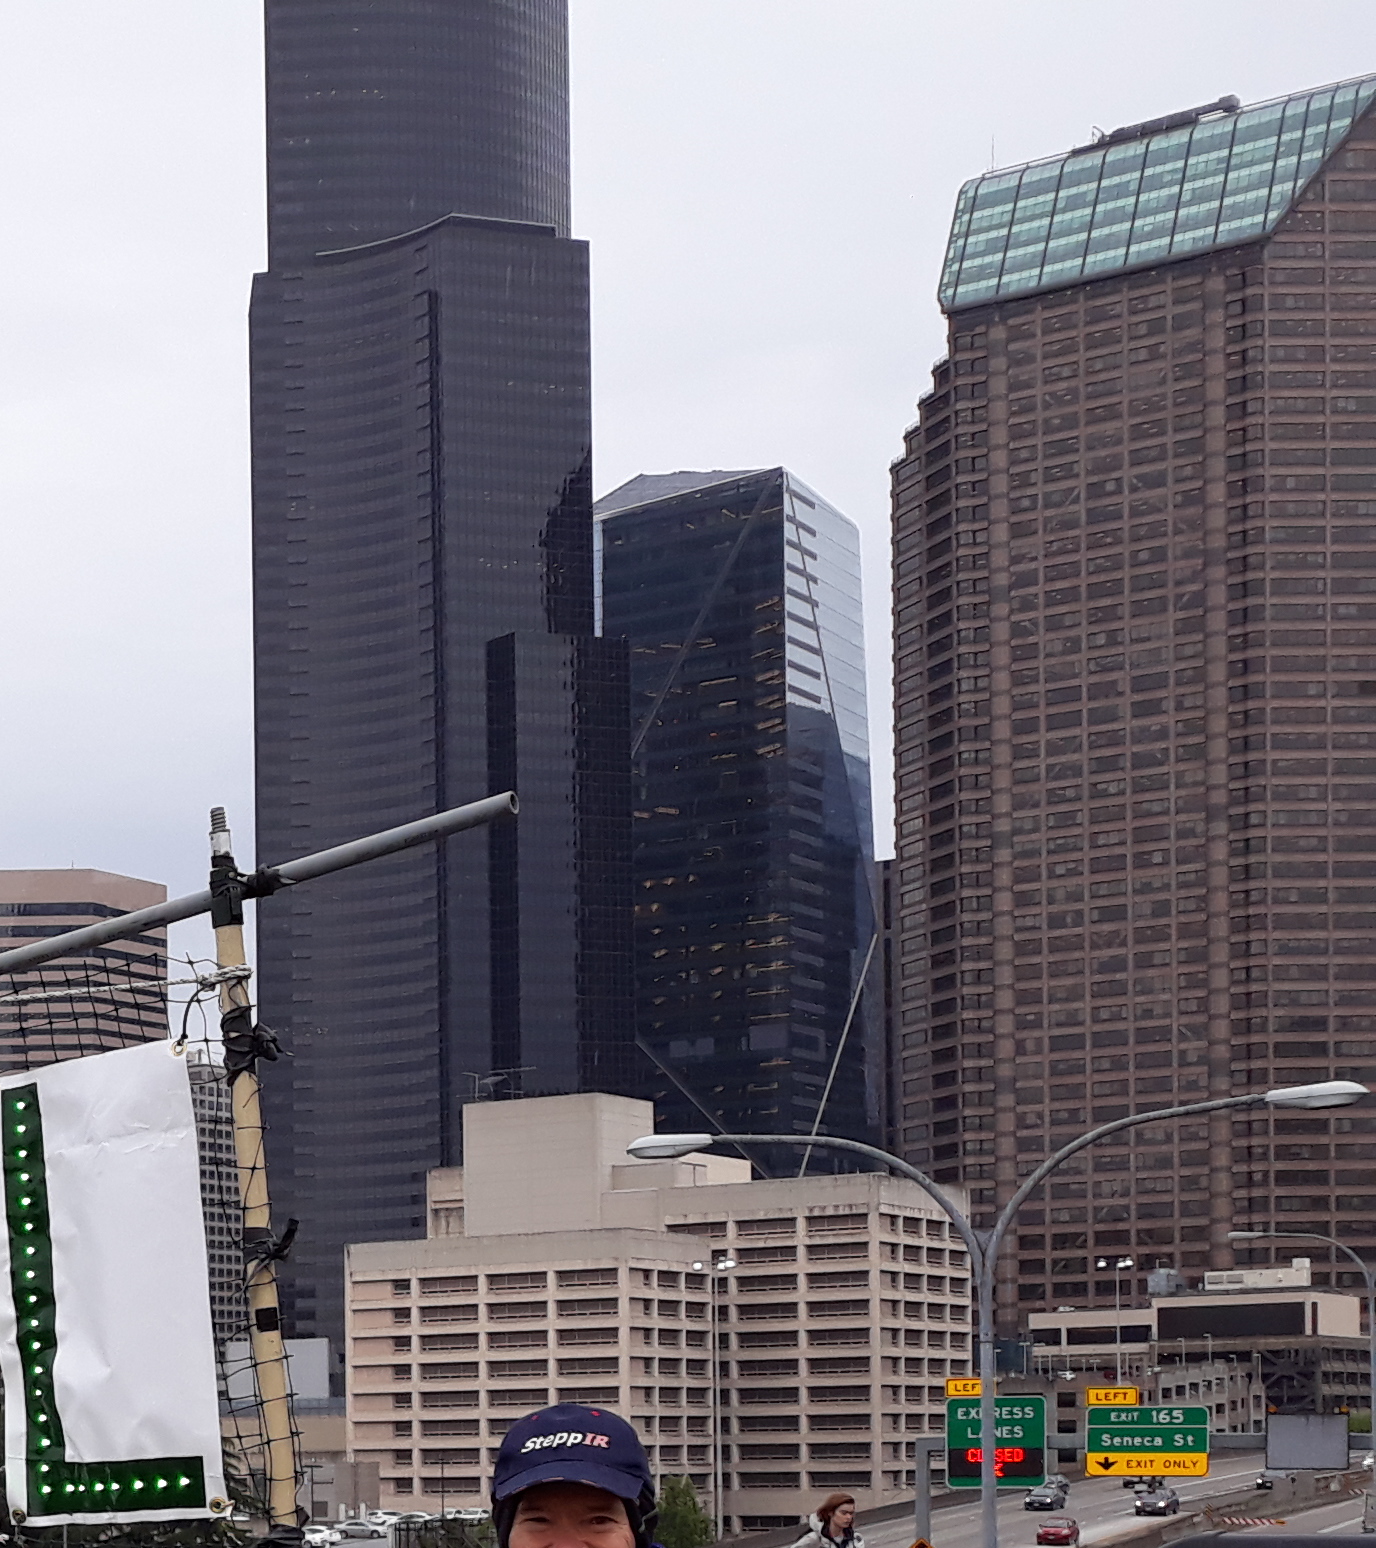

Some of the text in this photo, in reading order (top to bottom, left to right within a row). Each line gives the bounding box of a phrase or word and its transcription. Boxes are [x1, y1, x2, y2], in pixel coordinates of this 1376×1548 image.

[954, 1382, 980, 1392] LEF
[1095, 1392, 1128, 1401] LEFT
[1110, 1409, 1184, 1424] EXIT 165
[520, 1432, 610, 1454] SteppIR
[1100, 1433, 1195, 1446] Seneca St
[966, 1448, 1025, 1462] CLSED
[1126, 1459, 1199, 1468] EXIT ONLY
